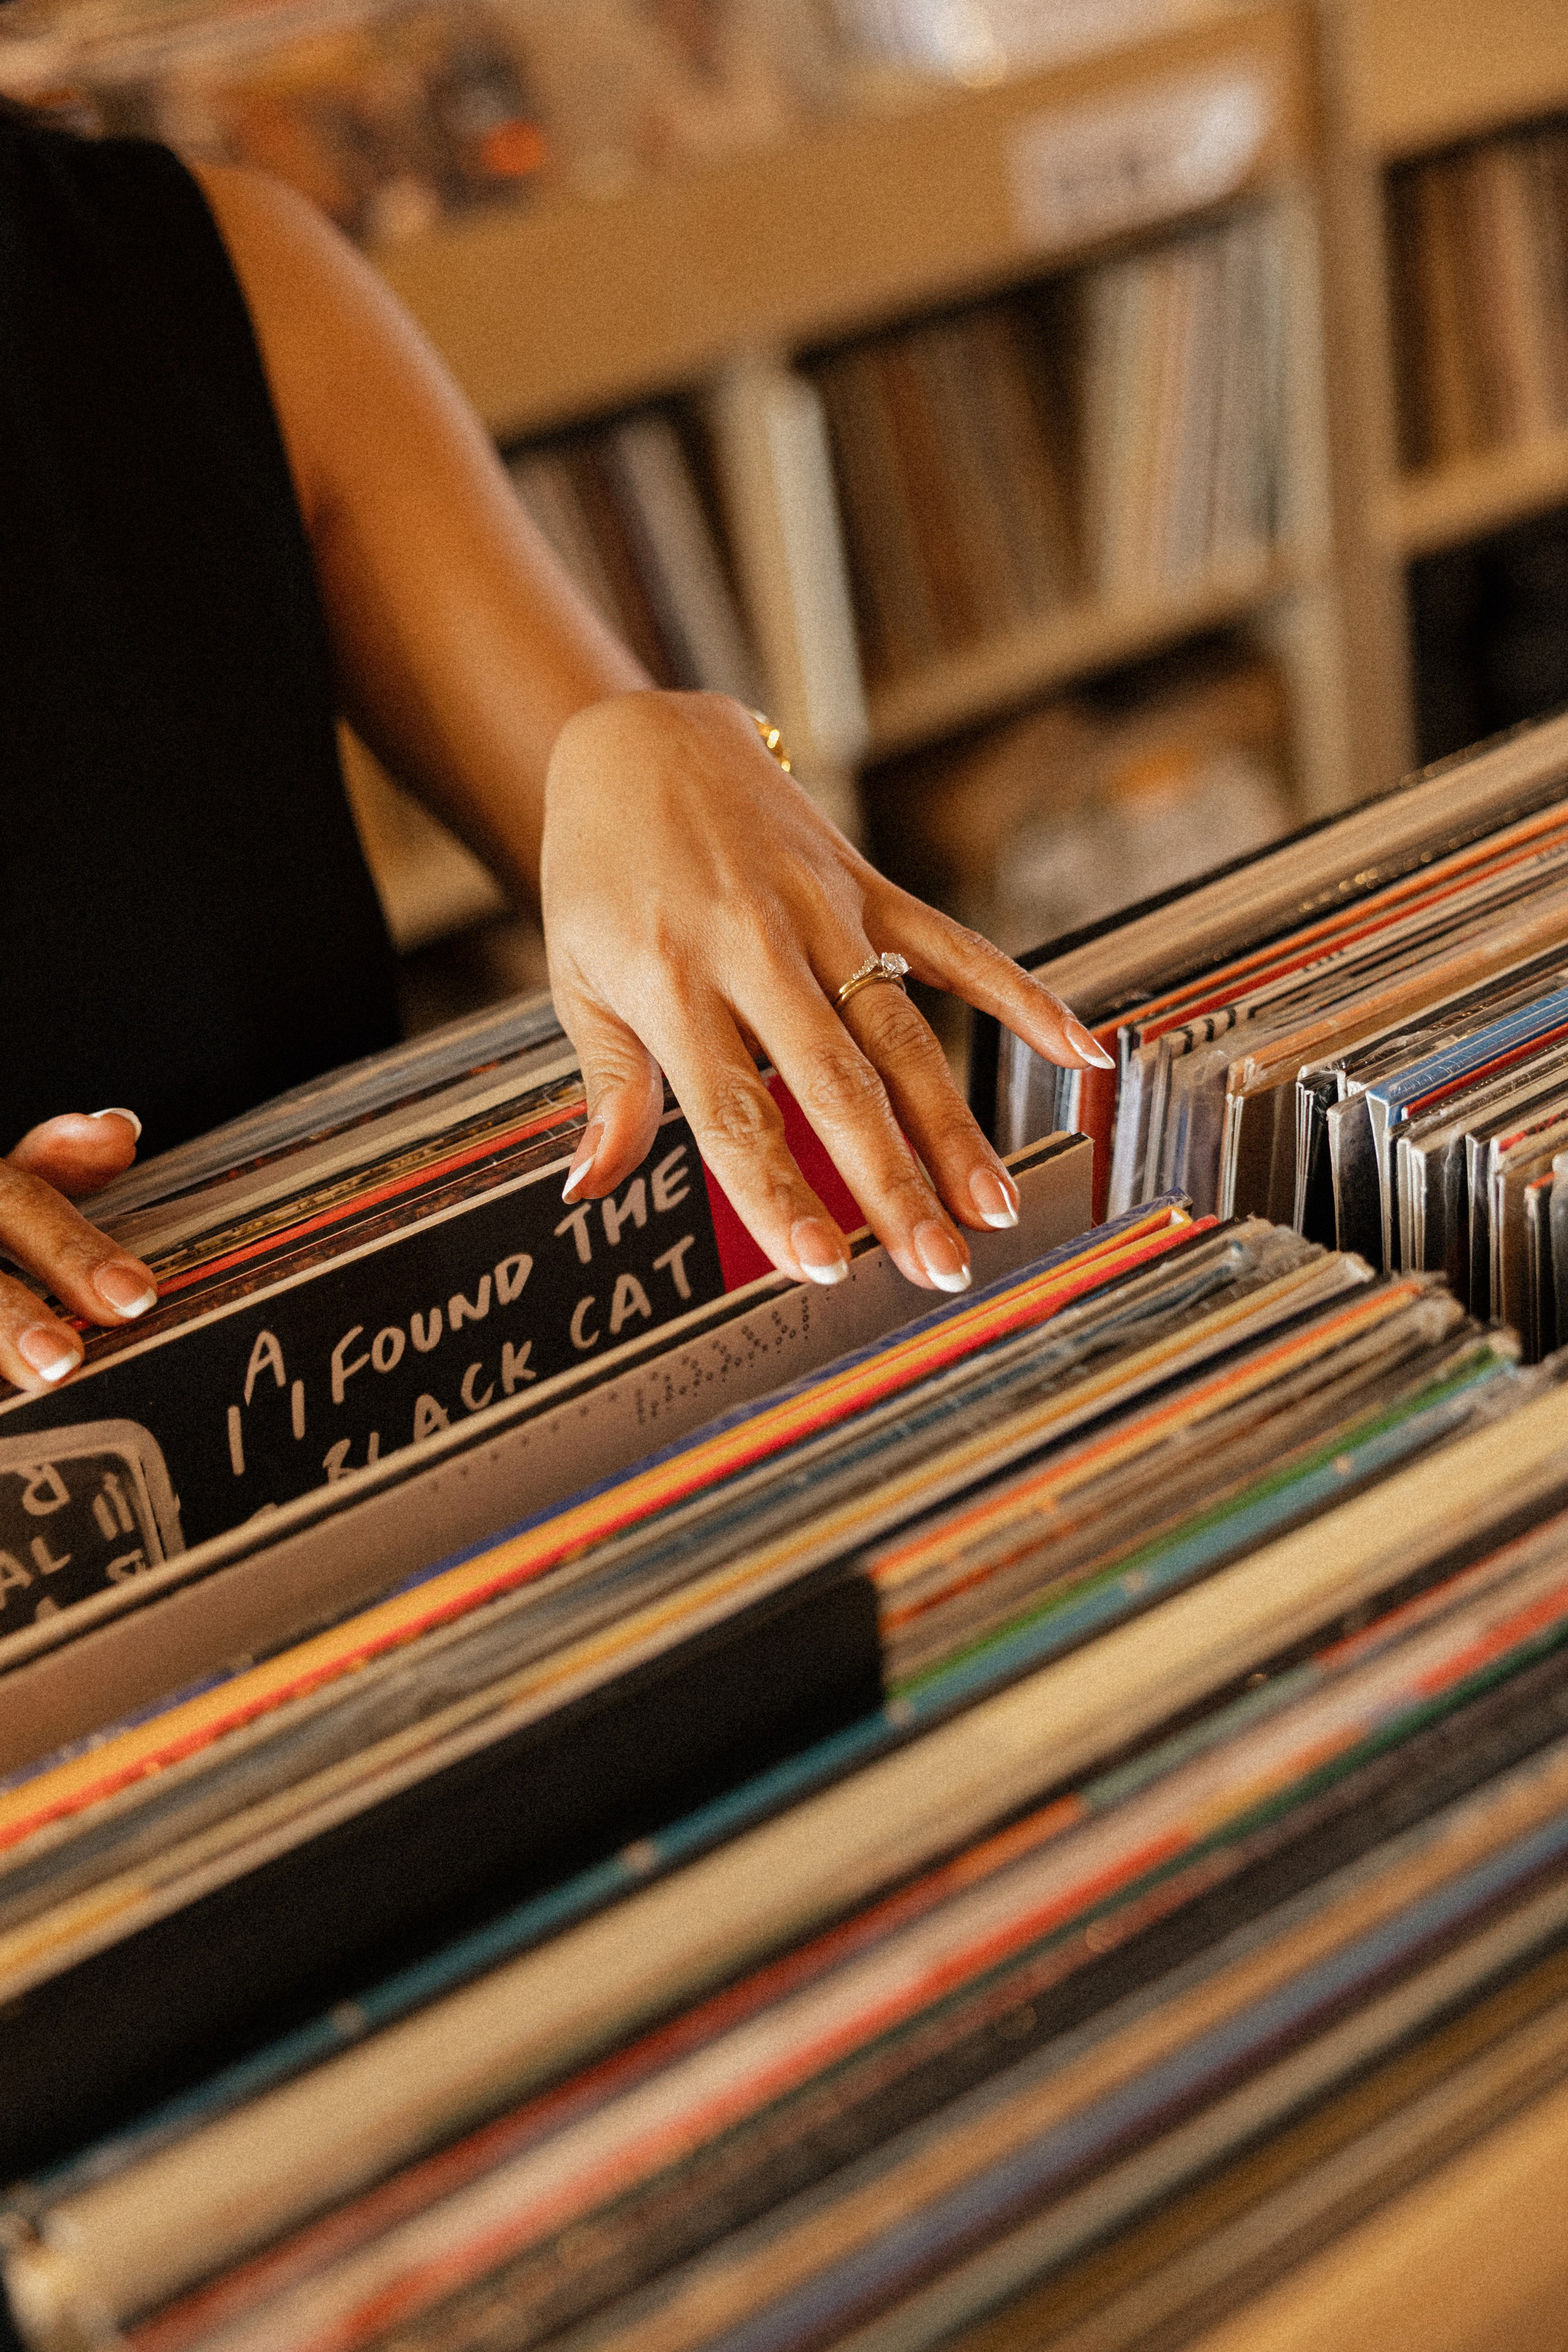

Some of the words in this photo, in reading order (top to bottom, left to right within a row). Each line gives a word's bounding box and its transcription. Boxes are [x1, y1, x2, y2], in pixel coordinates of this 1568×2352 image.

[331, 1252, 534, 1405] FOUND
[553, 1144, 692, 1265] THE
[569, 1233, 696, 1350] CAT
